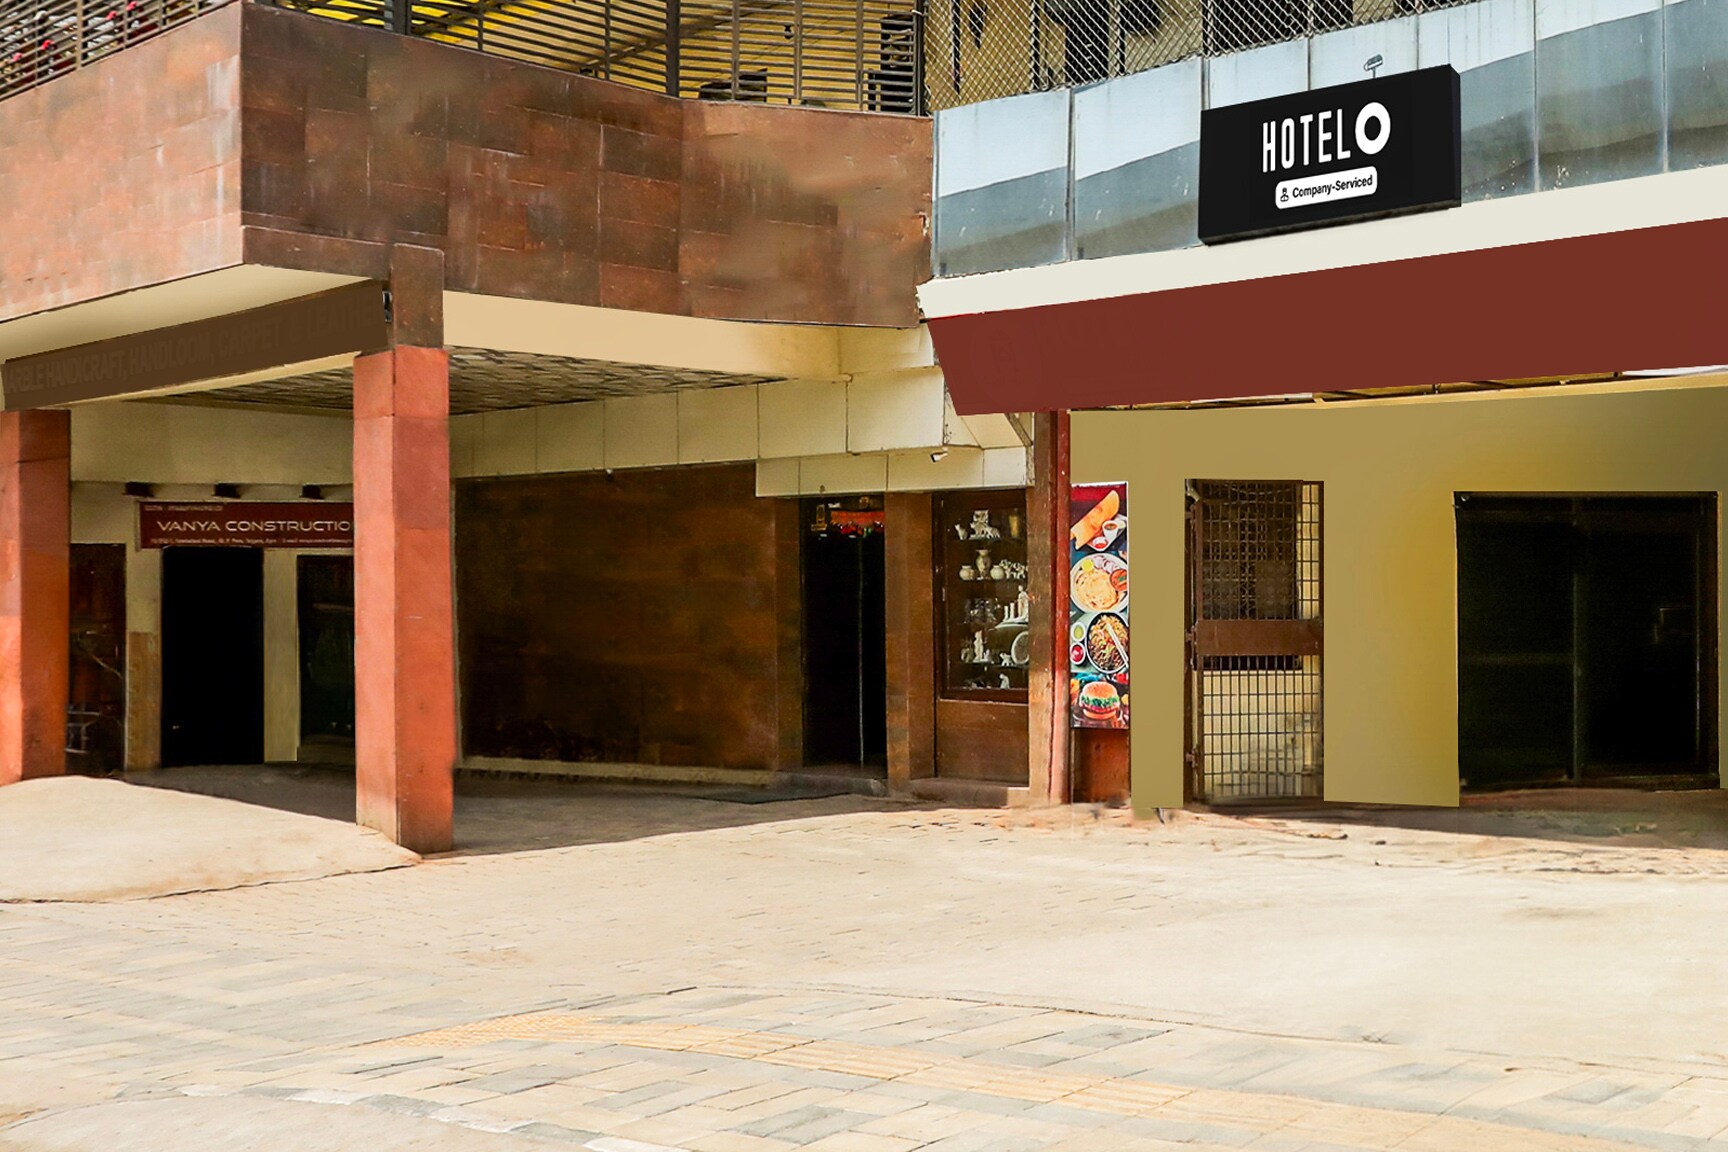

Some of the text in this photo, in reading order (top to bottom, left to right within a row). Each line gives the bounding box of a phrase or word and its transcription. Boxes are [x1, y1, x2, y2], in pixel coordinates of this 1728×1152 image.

[1262, 108, 1351, 173] HOTEL
[1292, 174, 1373, 198] Company-Serviced
[5, 363, 46, 394] ARBLE
[157, 520, 354, 532] VANYA CONSTRUCTIO
